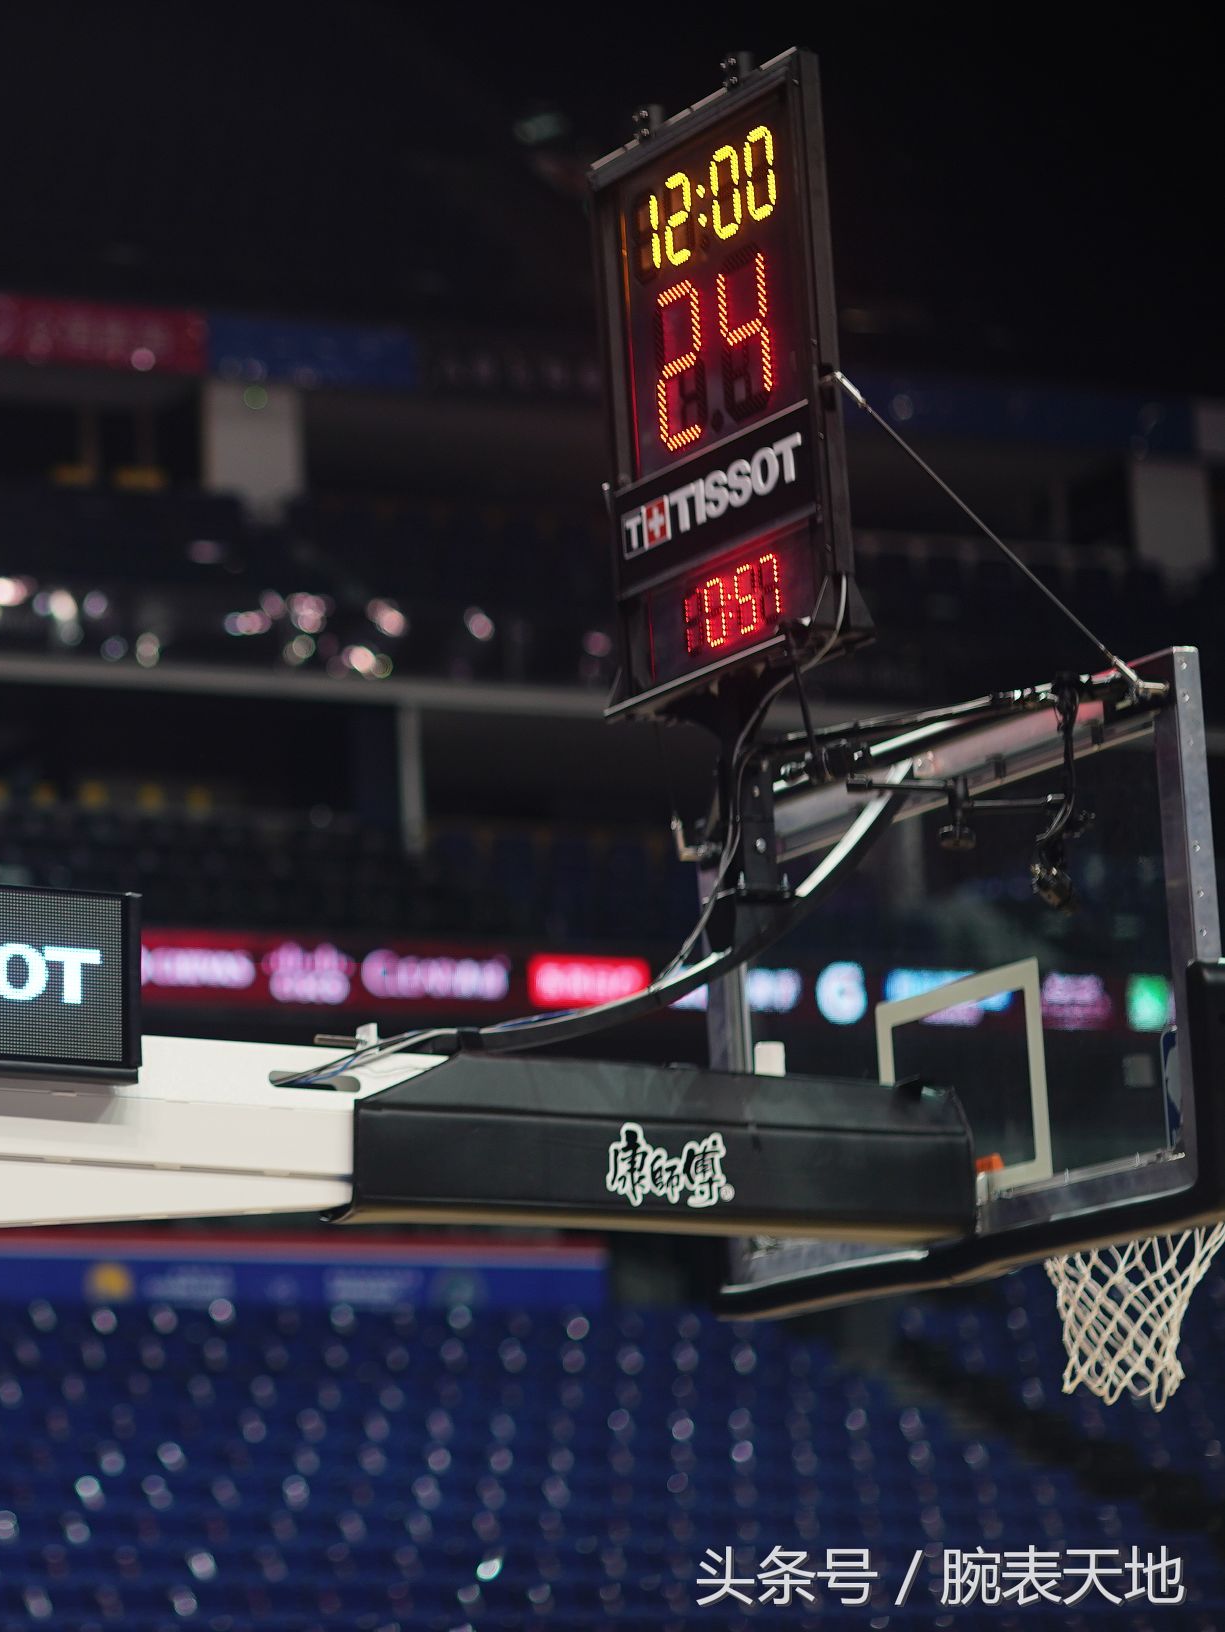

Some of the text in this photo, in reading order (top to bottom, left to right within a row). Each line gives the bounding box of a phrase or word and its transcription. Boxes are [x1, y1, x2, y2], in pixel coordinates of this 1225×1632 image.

[649, 125, 776, 268] 12:00
[657, 252, 774, 451] 24
[671, 433, 802, 535] TISSOT
